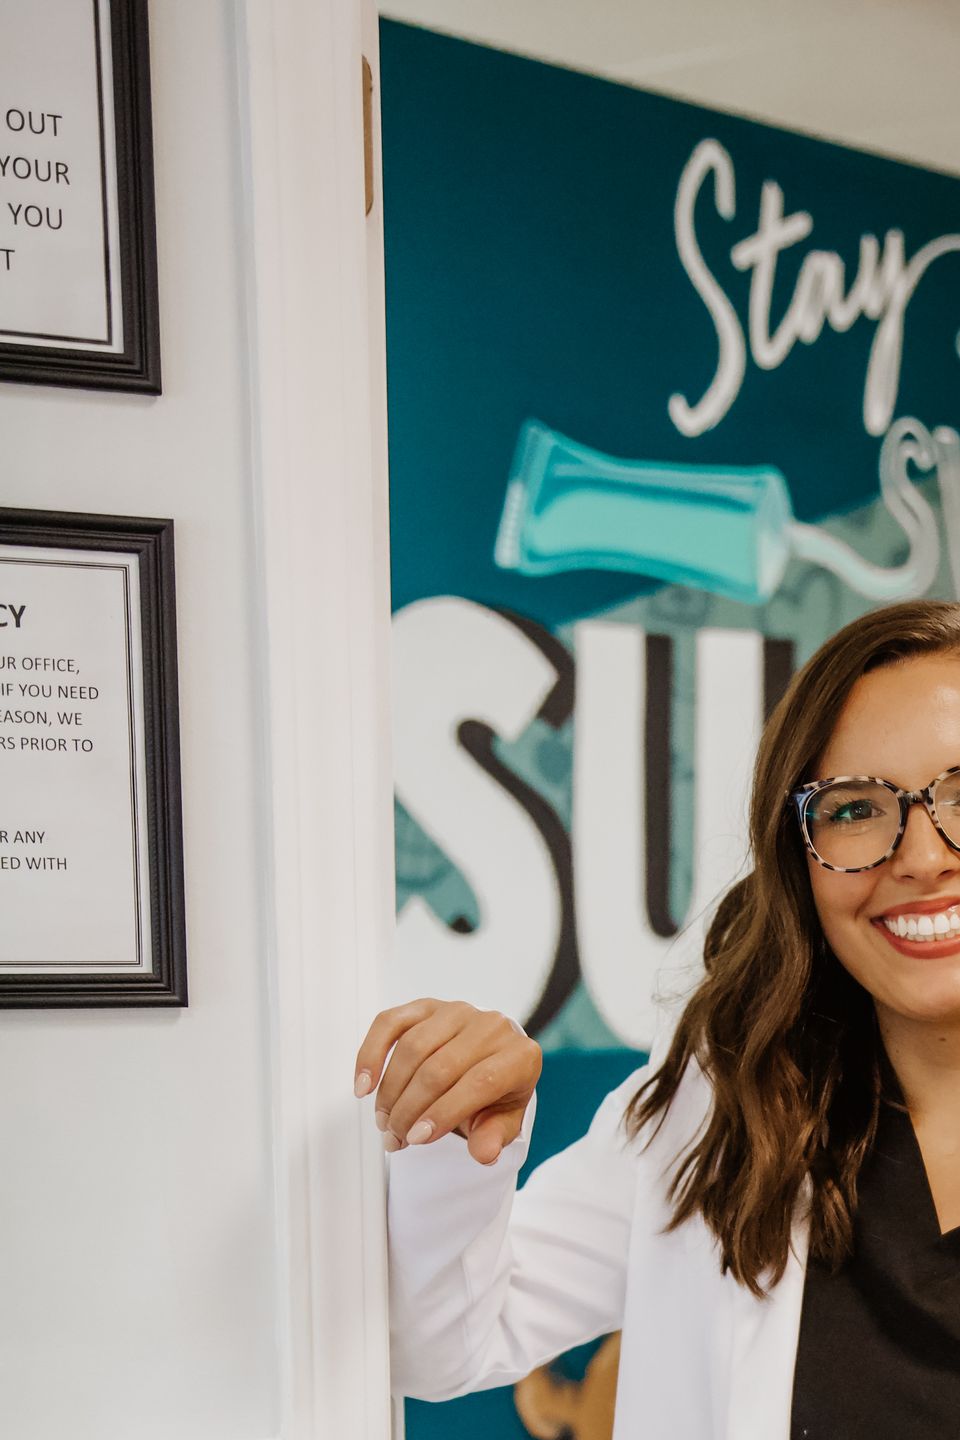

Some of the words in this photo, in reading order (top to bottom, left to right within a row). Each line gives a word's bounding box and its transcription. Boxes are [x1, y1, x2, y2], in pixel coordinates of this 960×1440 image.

[6, 108, 62, 137] OUT
[0, 155, 70, 185] YOUR
[8, 202, 63, 230] YOU
[667, 138, 912, 436] Stay
[21, 657, 80, 675] OFFICE,
[1, 683, 14, 697] IF
[18, 683, 52, 698] YOU
[57, 685, 99, 700] NEED
[57, 711, 83, 726] WE
[20, 737, 68, 752] PRIOR
[72, 738, 94, 752] TO
[13, 830, 46, 844] ANY
[0, 856, 21, 870] ED
[25, 857, 67, 870] WITH
